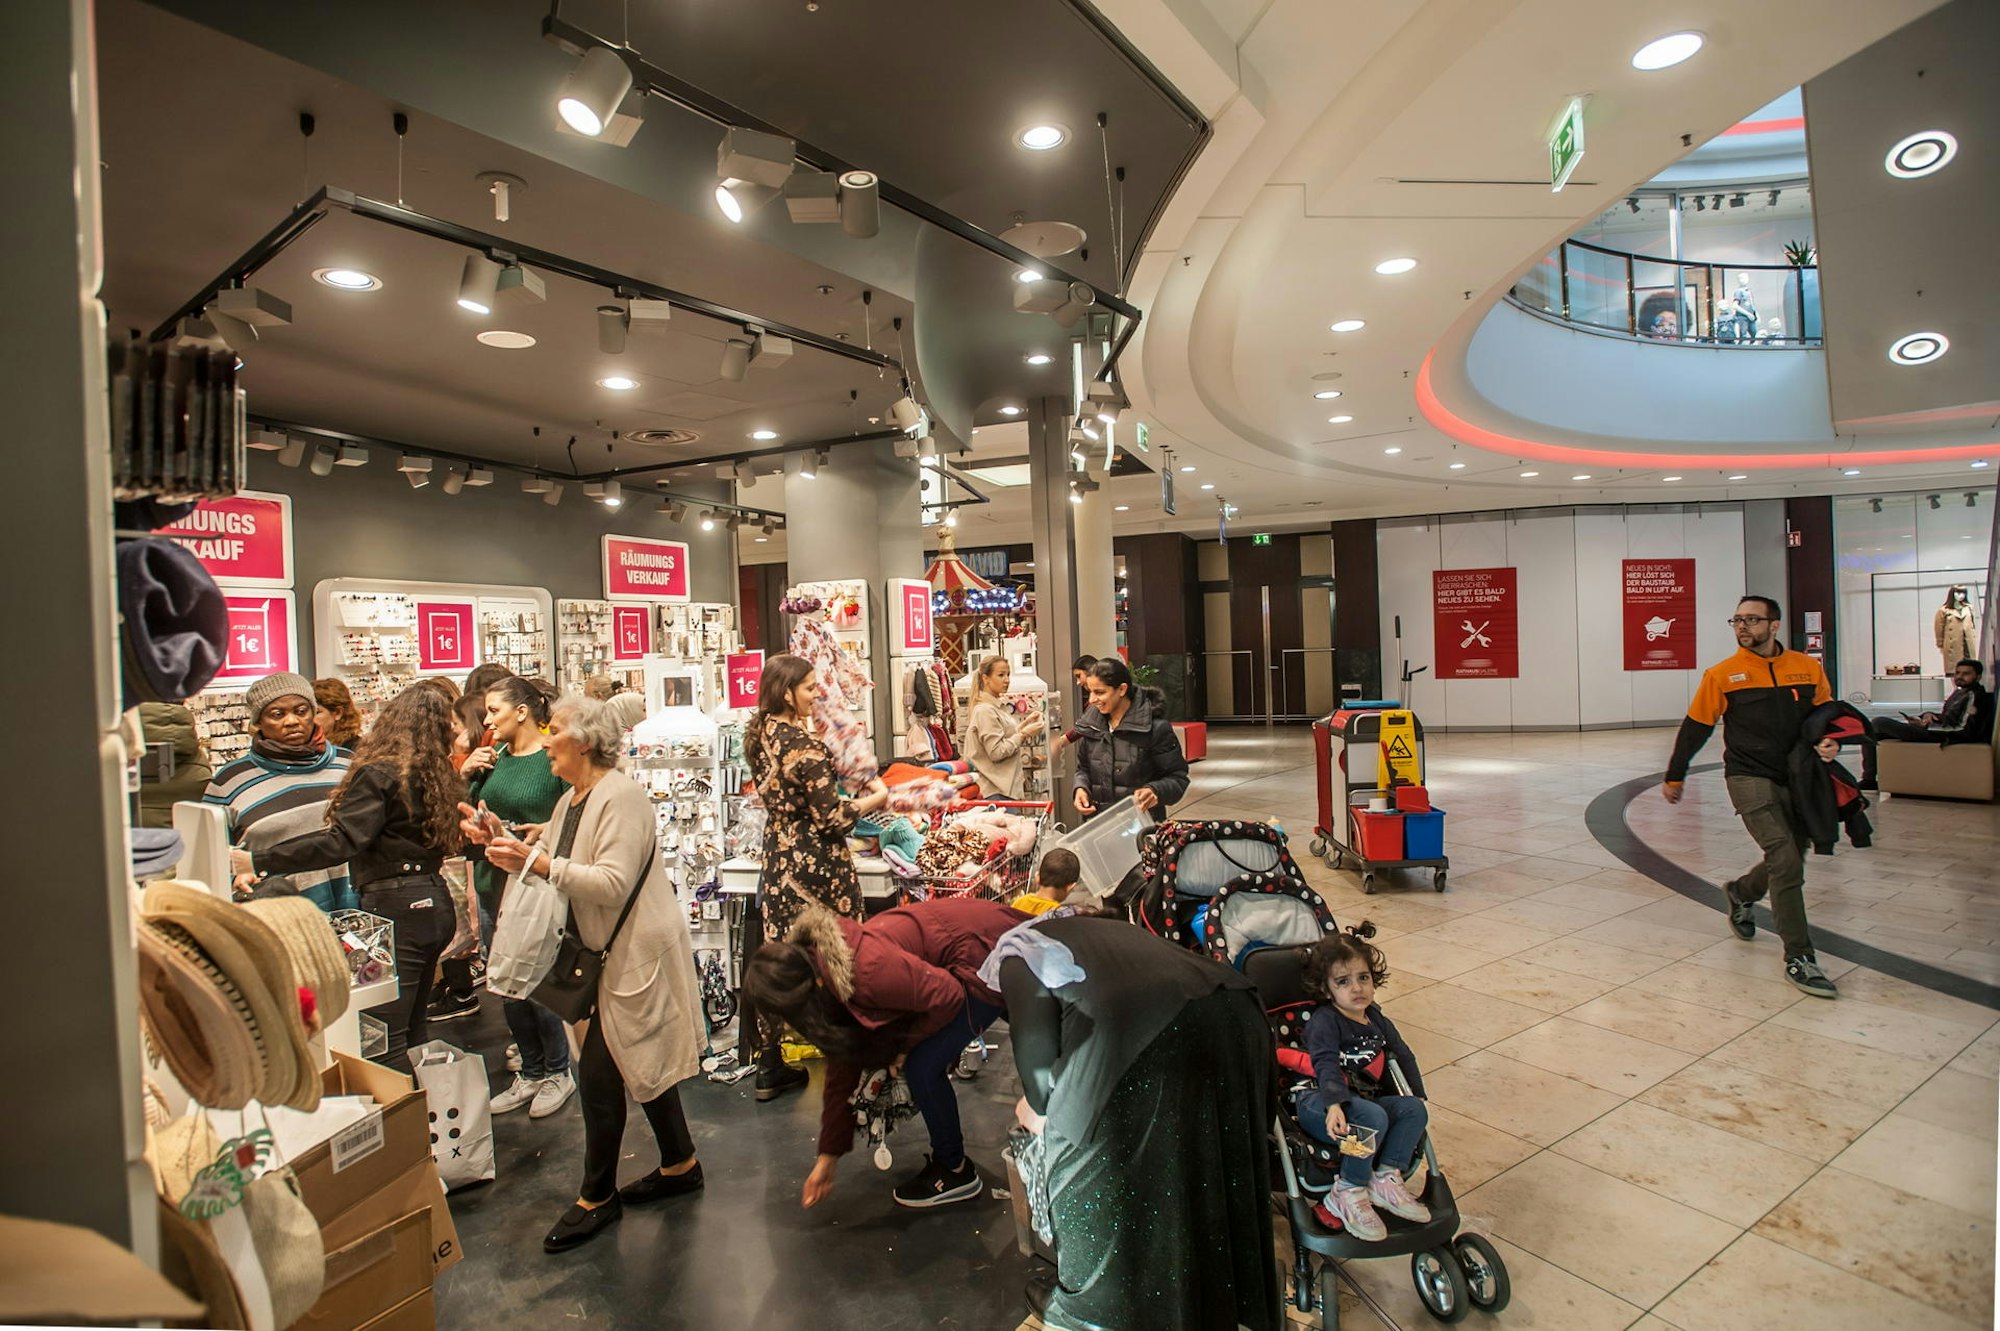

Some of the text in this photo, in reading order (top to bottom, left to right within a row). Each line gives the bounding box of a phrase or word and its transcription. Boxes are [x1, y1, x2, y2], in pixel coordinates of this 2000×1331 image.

[620, 549, 675, 569] RÄUMUNGS
[626, 569, 670, 586] VERKAUF
[236, 633, 259, 653] 1€
[437, 634, 454, 650] 1€
[626, 630, 637, 643] 1€
[735, 676, 757, 696] 1€
